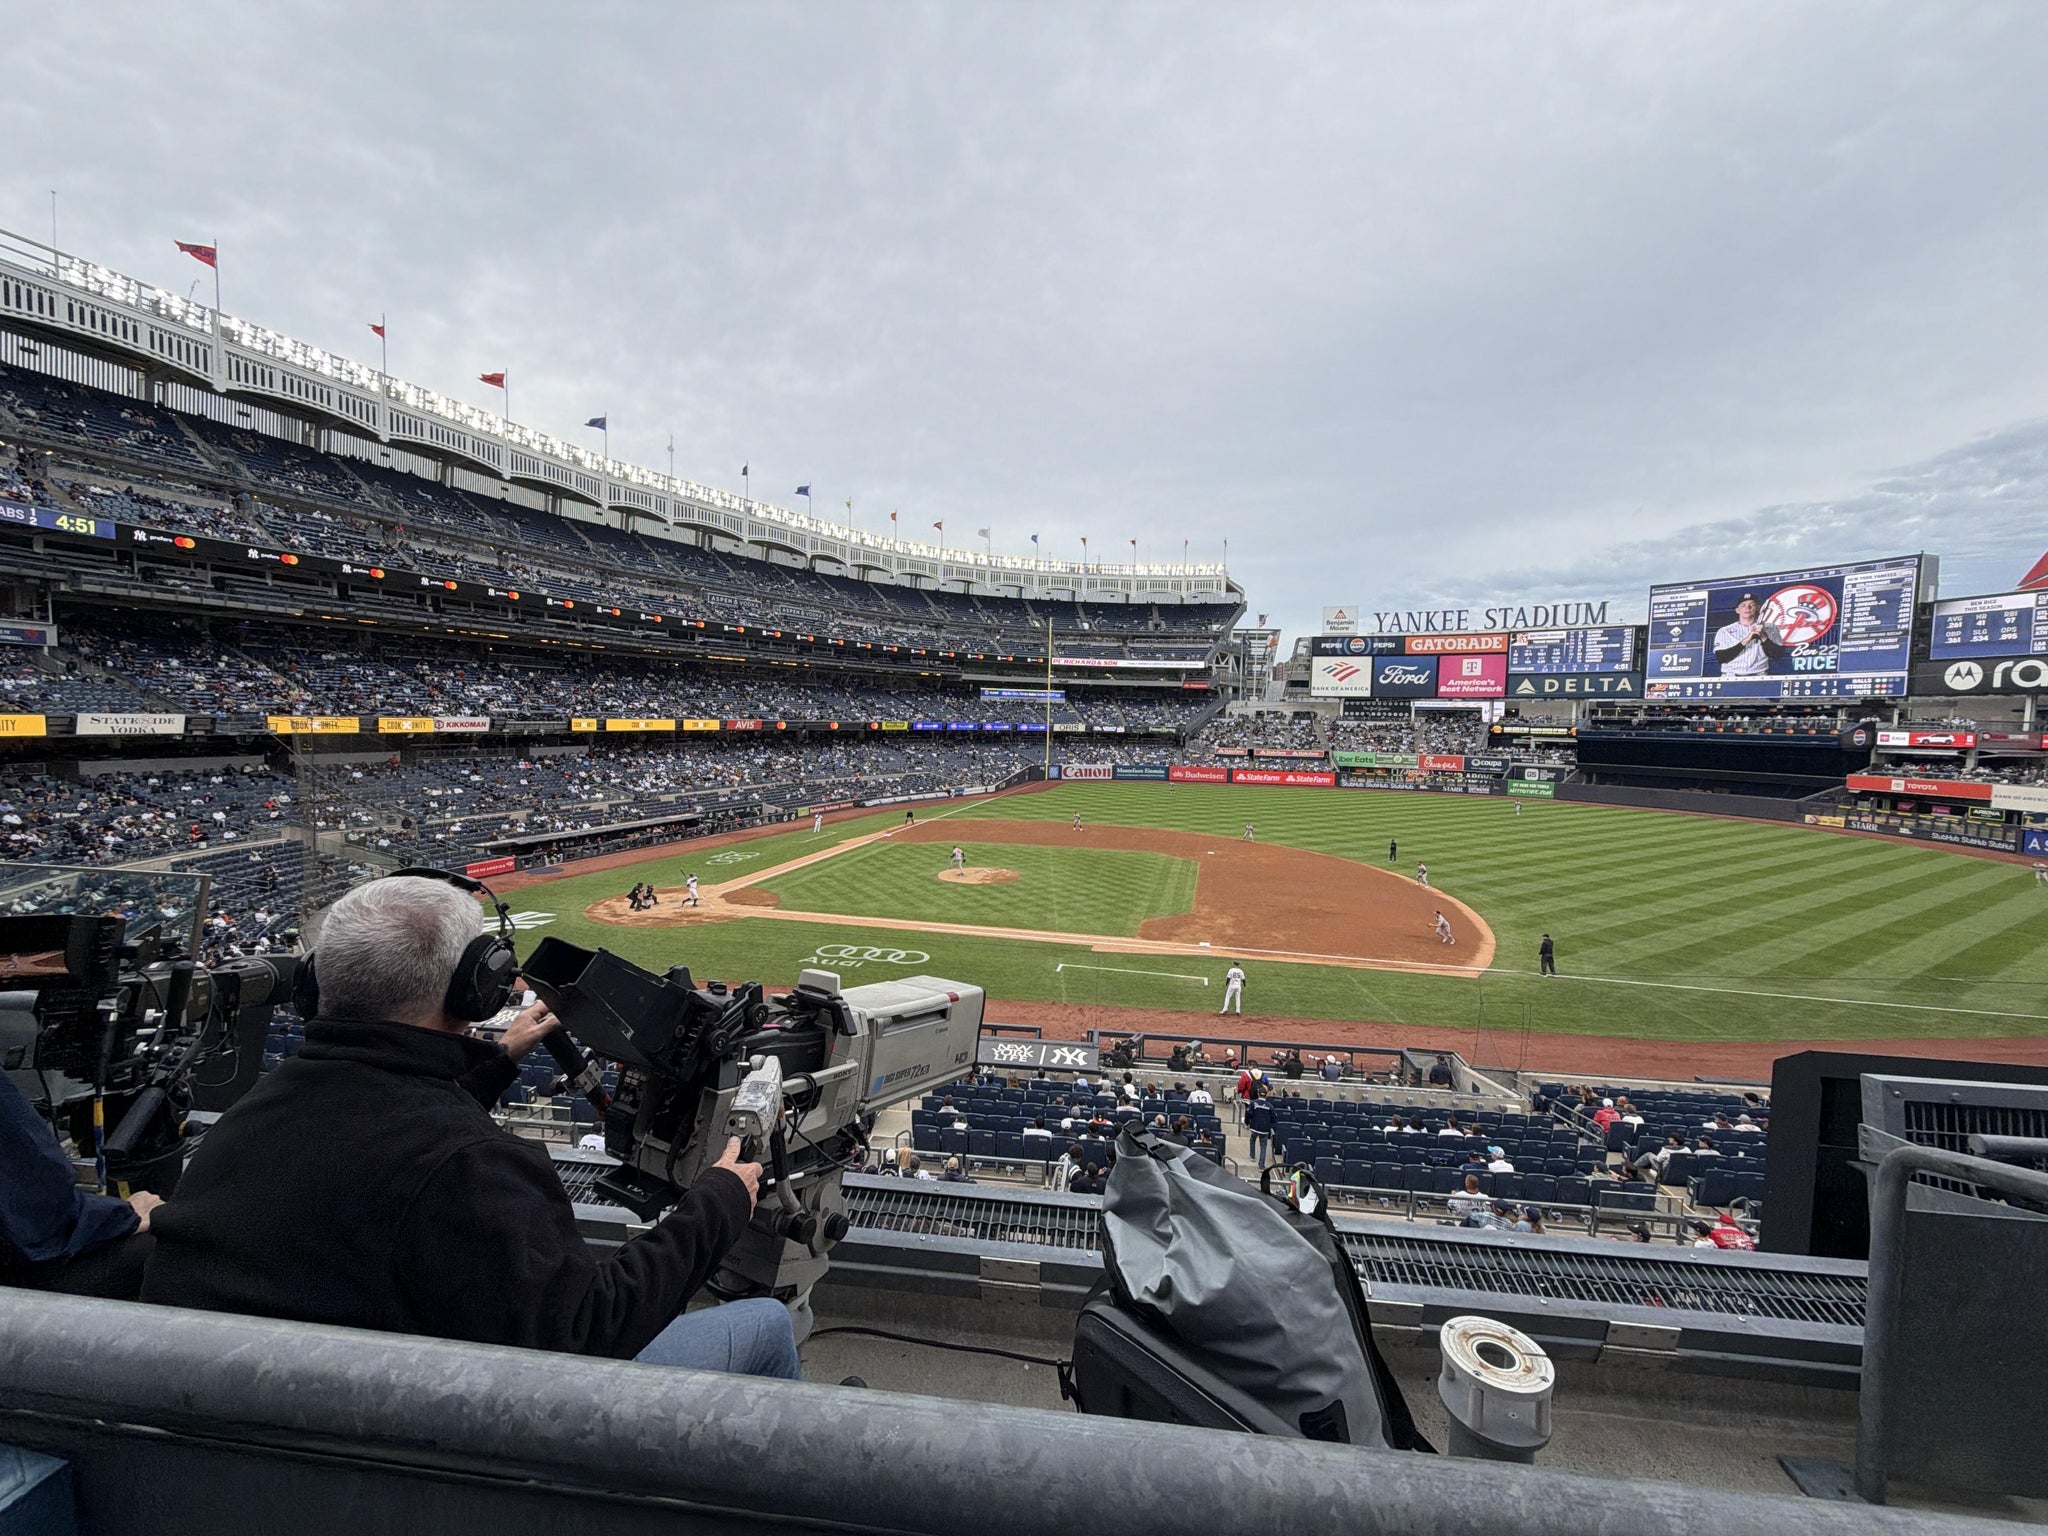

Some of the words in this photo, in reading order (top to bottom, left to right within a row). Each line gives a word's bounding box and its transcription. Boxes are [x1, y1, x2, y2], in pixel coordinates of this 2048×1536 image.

[55, 514, 96, 535] 4:51
[1372, 609, 1469, 632] YANKEE
[1484, 600, 1610, 630] STADIUM
[1326, 619, 1355, 627] Benjamin
[1972, 628, 1987, 636] SLG
[1411, 636, 1502, 651] GATORADE
[1790, 643, 1818, 656] Ben
[1818, 644, 1839, 656] 22
[1661, 654, 1678, 667] 91
[1791, 655, 1838, 671] RICE
[1378, 664, 1430, 686] Ford
[1448, 678, 1496, 686] America's
[1544, 677, 1633, 693] DELTA
[1440, 685, 1460, 693] Best
[1461, 685, 1503, 693] Network
[0, 719, 17, 732] ITY
[110, 726, 156, 734] VODKA
[445, 721, 487, 729] KIKKOMAN
[734, 720, 755, 730] AVIS
[1354, 756, 1374, 764] Eats
[1480, 759, 1503, 767] coupa
[1062, 766, 1112, 778] Canon
[1184, 770, 1224, 780] Budweiser
[1906, 783, 1938, 791] TOYOTA
[1850, 821, 1879, 832] STARR
[1931, 832, 1960, 842] StubHub
[1961, 836, 1988, 847] StubHub
[1988, 841, 2016, 851] StubHub
[798, 956, 865, 968] Audi
[991, 1047, 1035, 1058] YORK
[997, 1043, 1033, 1052] NEW
[994, 1055, 1028, 1063] LIFE
[832, 1068, 852, 1080] SONY
